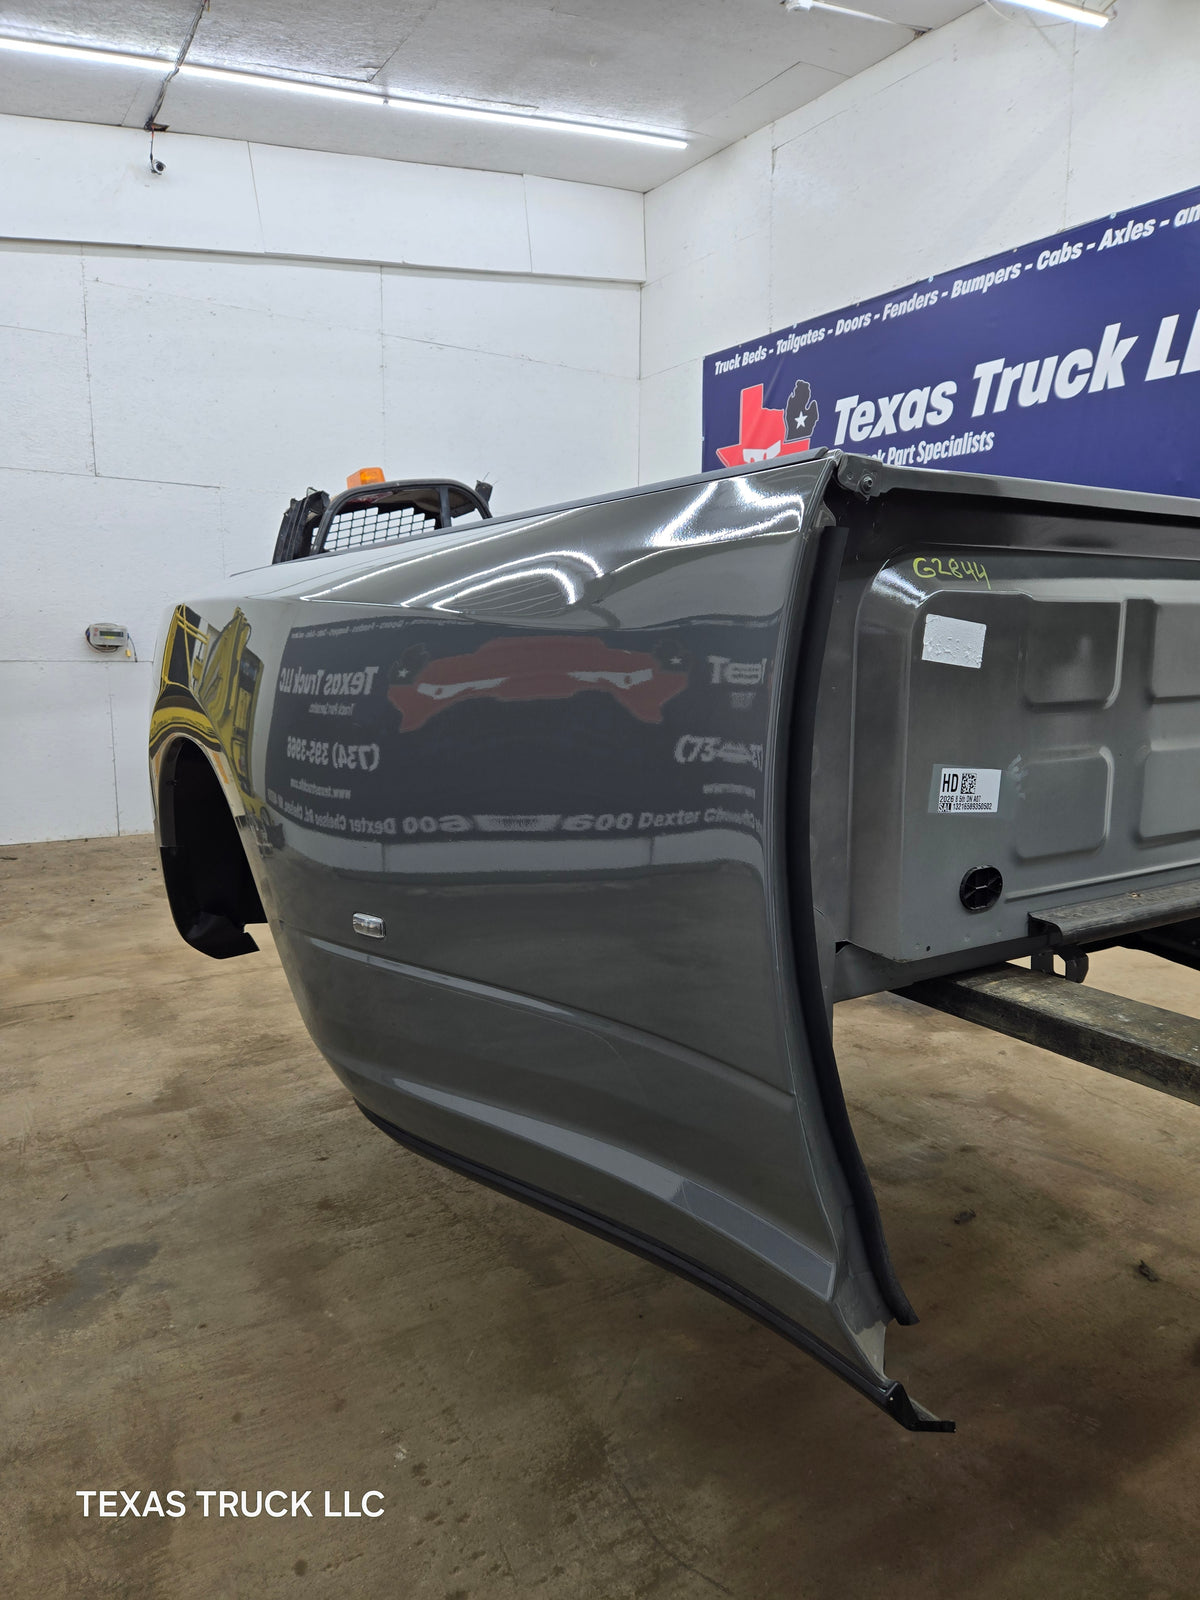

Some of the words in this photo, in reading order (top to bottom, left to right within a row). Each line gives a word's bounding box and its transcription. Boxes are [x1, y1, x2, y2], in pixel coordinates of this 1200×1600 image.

[715, 354, 741, 376] Truck
[742, 346, 767, 367] Beds
[776, 327, 826, 356] Tailgates
[835, 312, 872, 337] Doors
[882, 290, 939, 322] Fenders
[950, 262, 1022, 299] Bumpers
[1036, 241, 1083, 271] Cabs
[1097, 219, 1156, 252] Axles
[834, 380, 957, 446] Texas
[971, 322, 1139, 418] Truck
[887, 444, 916, 466] Part
[916, 430, 995, 464] Specialists
[942, 773, 959, 792] HD
